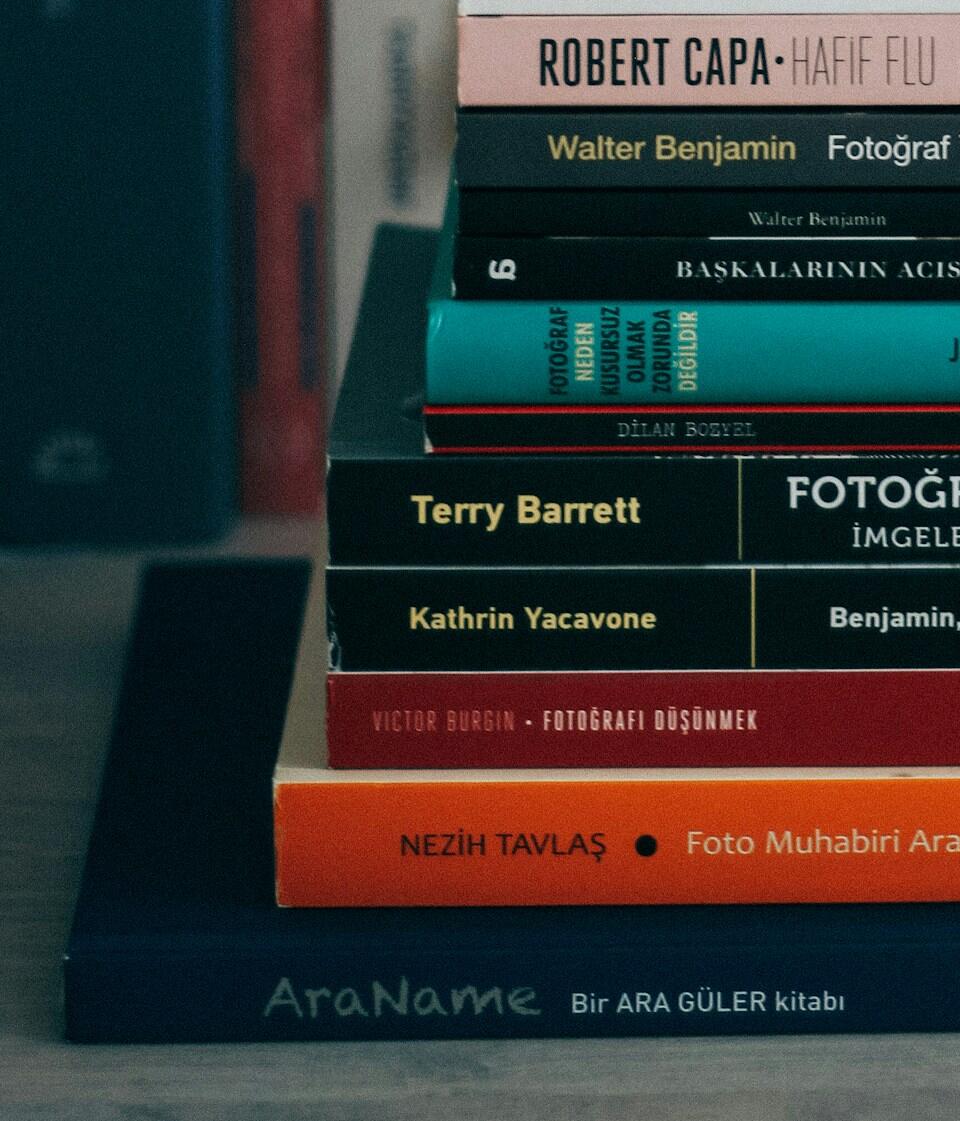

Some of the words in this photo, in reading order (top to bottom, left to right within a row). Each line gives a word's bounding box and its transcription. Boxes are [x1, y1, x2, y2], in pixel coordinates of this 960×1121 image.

[539, 37, 670, 87] ROBERT
[684, 36, 770, 87] CAPA
[791, 35, 873, 86] HAFİF
[885, 34, 936, 87] FLU
[547, 134, 647, 161] Walter
[655, 134, 797, 167] Benjamin
[828, 134, 952, 167] Fotoğraf
[748, 211, 804, 227] Walter
[808, 211, 887, 228] Benjamin
[676, 260, 887, 283] BAŞKALARININ
[544, 306, 569, 395] FOTOĞRAF
[574, 322, 595, 381] NEDEN
[600, 306, 621, 395] KUSURSUZ
[626, 320, 646, 383] OLMAK
[652, 309, 672, 393] ZORUNDA
[673, 311, 698, 392] DEĞİLDİR
[616, 418, 676, 439] DİLAN
[684, 421, 757, 438] BOZYEL
[410, 494, 505, 532] Terry
[517, 494, 641, 525] Barrett
[409, 605, 515, 630] Kathrin
[523, 606, 657, 630] Yacavone
[372, 709, 437, 734] VICTOR
[446, 709, 515, 732] BURGIN
[543, 706, 644, 732] FOTOĞRAFI
[654, 705, 757, 735] DÜŞÜNMEK
[399, 828, 487, 858] NEZİH
[495, 831, 607, 864] TAVLAŞ
[686, 829, 756, 856] Foto
[765, 827, 900, 855] Muhabiri
[571, 992, 610, 1014] Bir
[616, 991, 671, 1014] ARA
[677, 986, 767, 1013] GÜLER
[774, 990, 845, 1012] kitabı
